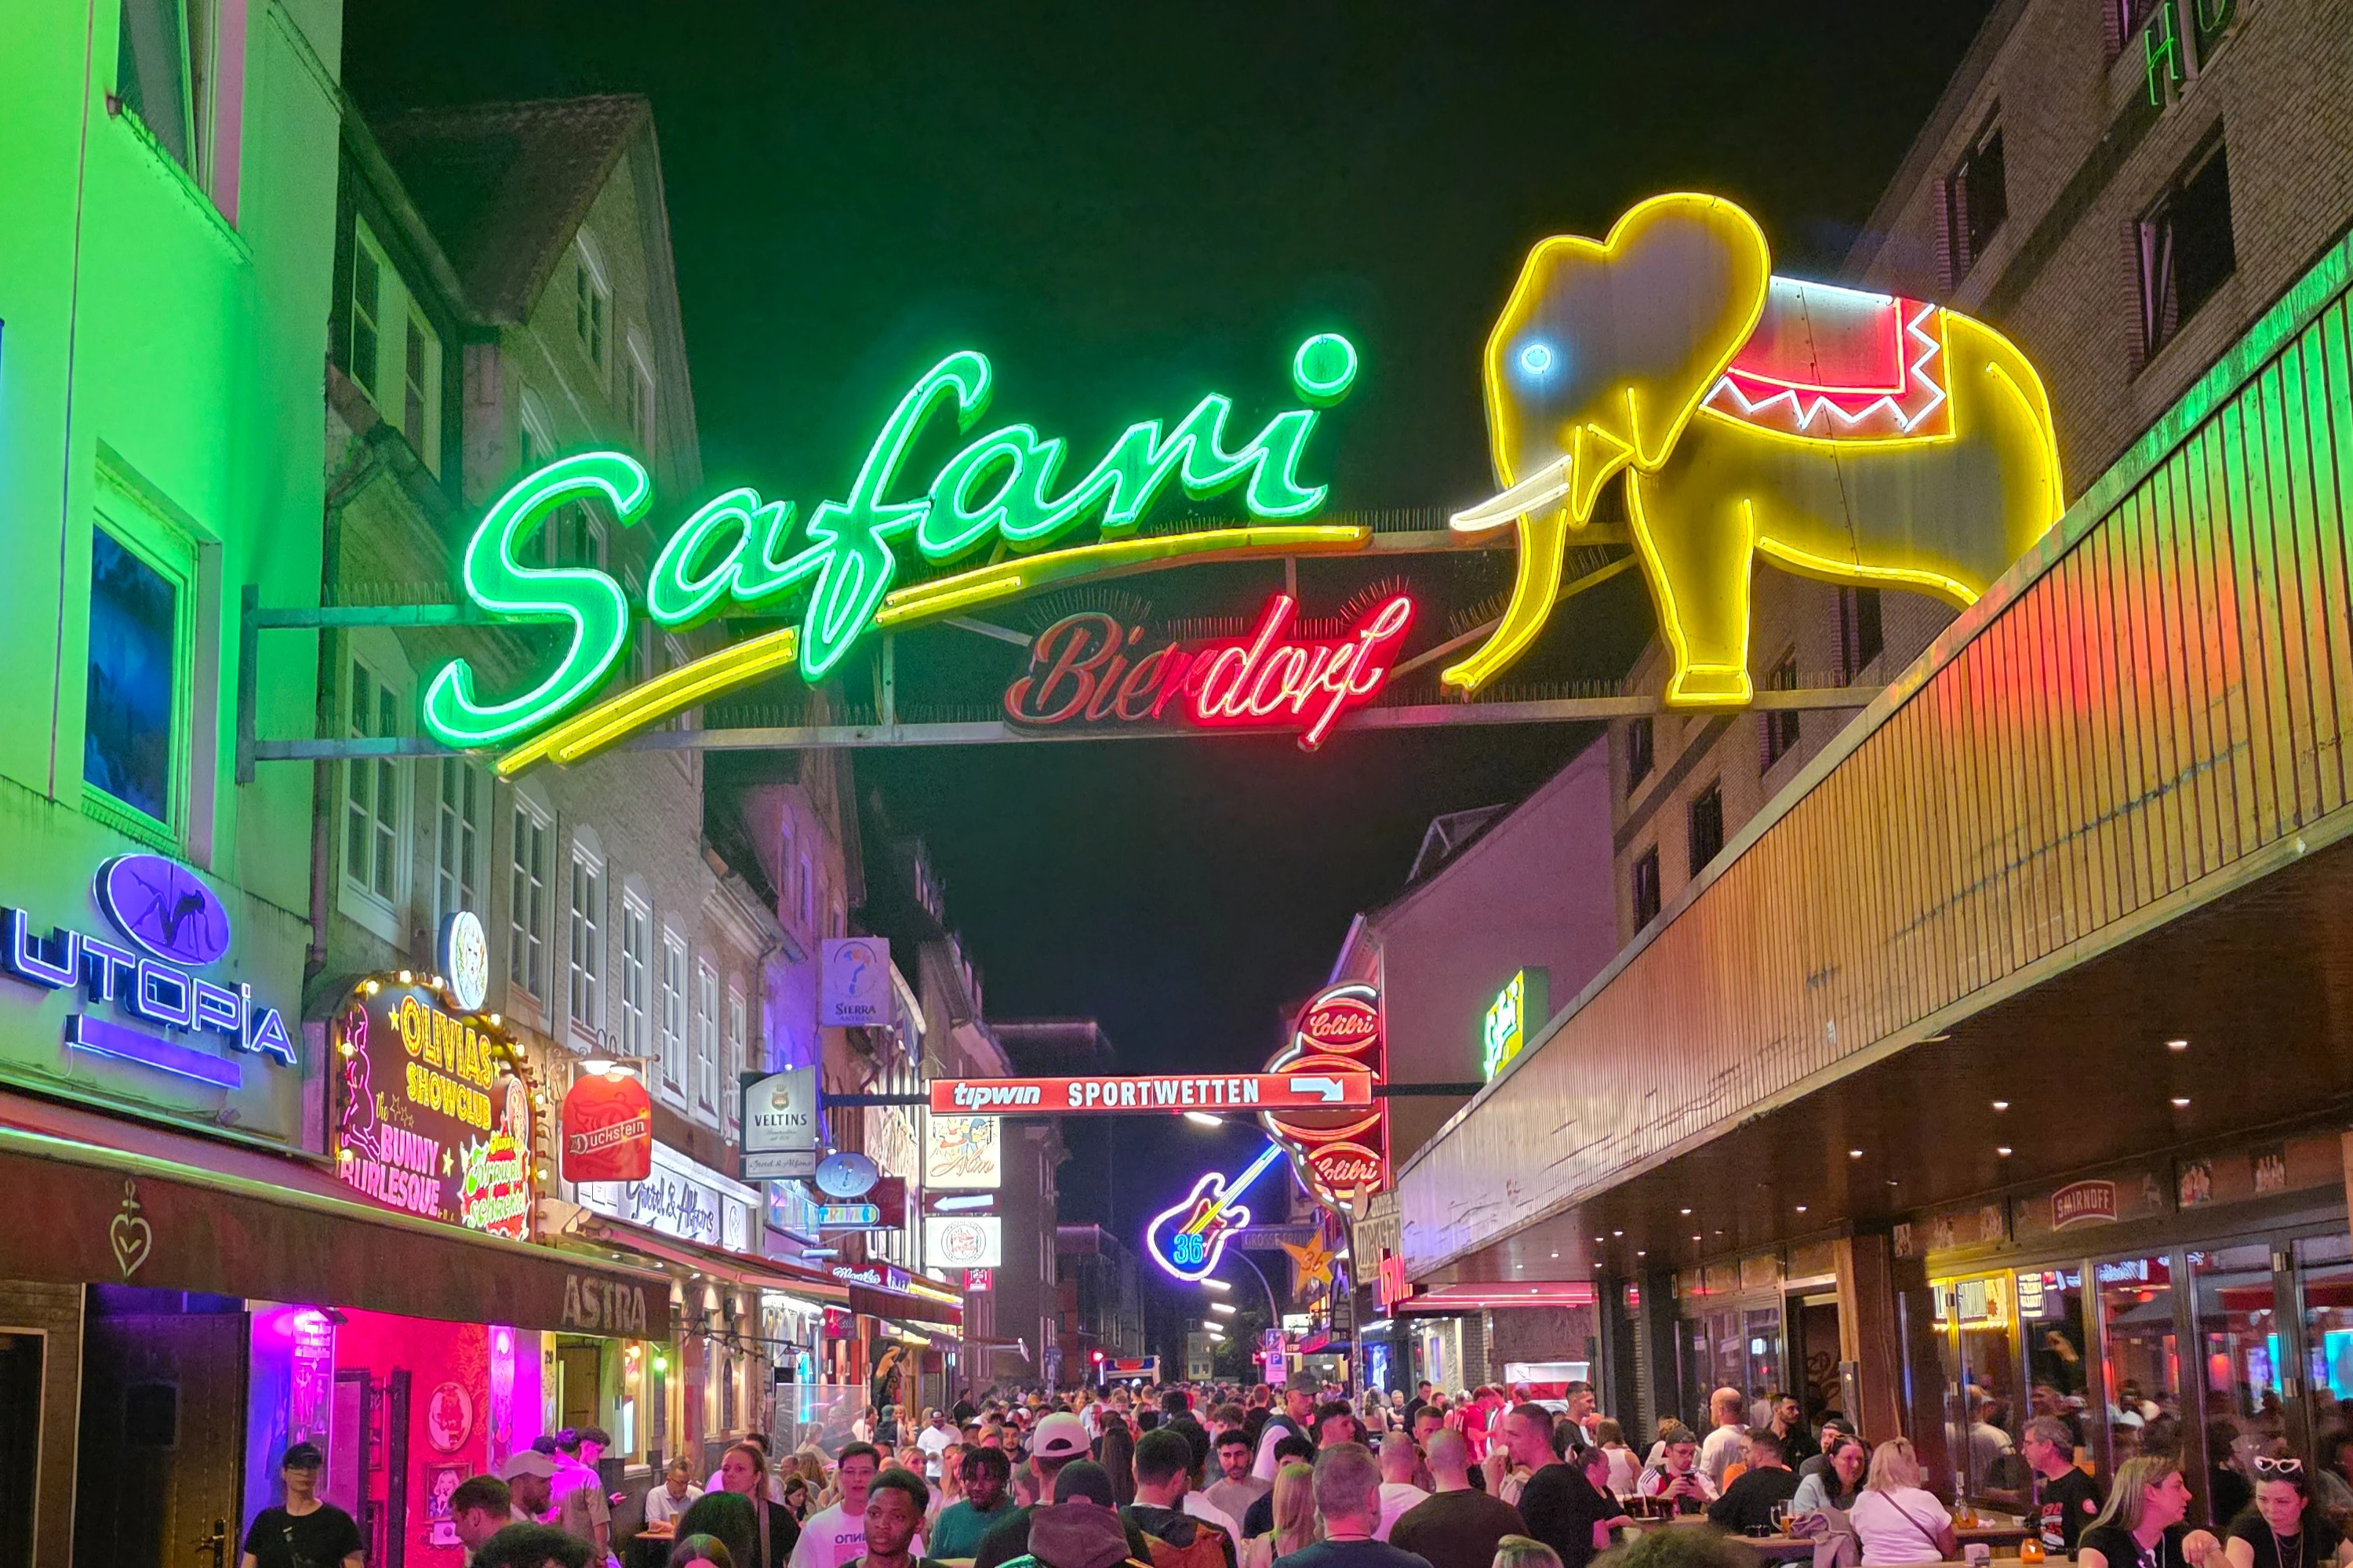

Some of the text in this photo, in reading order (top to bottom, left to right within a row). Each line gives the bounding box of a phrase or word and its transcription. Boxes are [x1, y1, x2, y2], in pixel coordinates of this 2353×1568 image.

[424, 333, 1359, 749] Safari
[1004, 595, 1414, 751] Bierdorf
[1310, 1013, 1374, 1036] Colibri
[400, 995, 493, 1090] OLIVIAS
[406, 1060, 492, 1131] SHOWCLUB
[954, 1079, 1260, 1110] tipwin SPORTWETTEN
[755, 1113, 807, 1127] VELTINS
[380, 1122, 439, 1177] BUNNY
[569, 1120, 646, 1155] Duckstein
[1315, 1157, 1378, 1181] Colibri
[2057, 1188, 2110, 1218] SMIRNOFF
[1173, 1233, 1203, 1264] 36
[1301, 1251, 1324, 1273] 36
[560, 1274, 646, 1333] ASTRA
